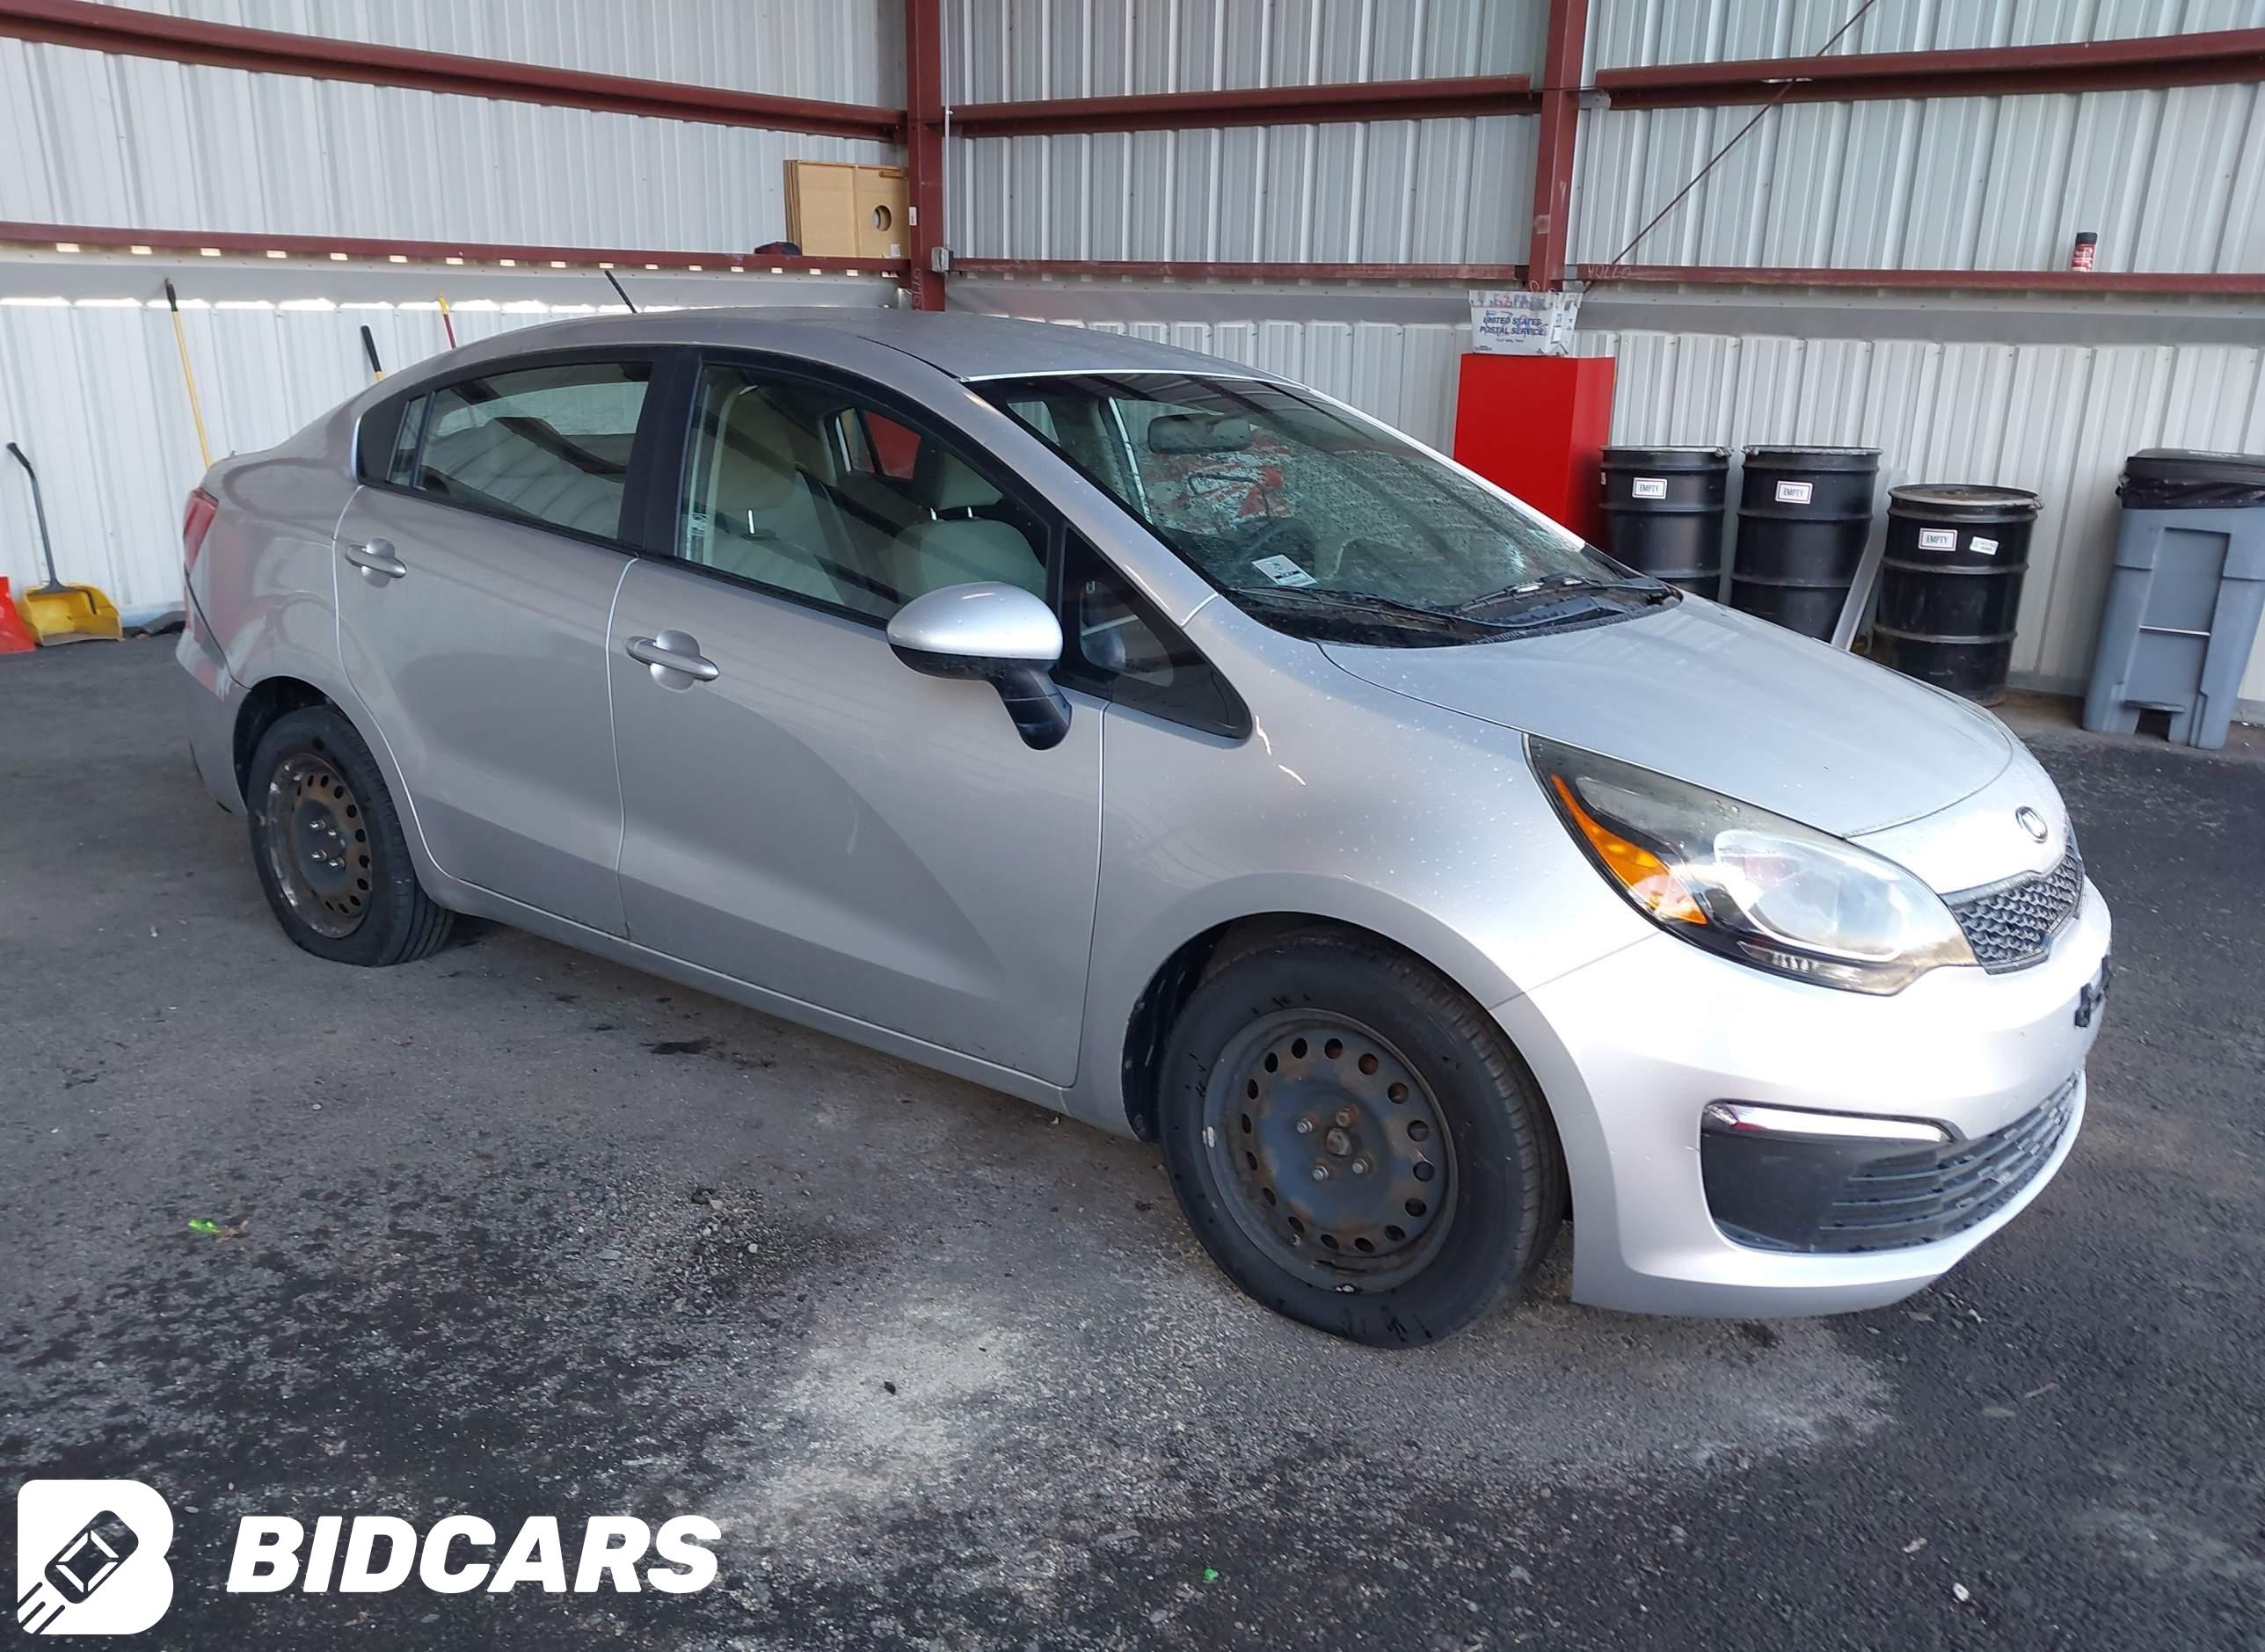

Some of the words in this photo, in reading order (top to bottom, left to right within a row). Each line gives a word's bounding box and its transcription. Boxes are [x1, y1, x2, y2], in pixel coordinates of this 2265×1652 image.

[1482, 317, 1511, 325] UNITED
[1511, 317, 1542, 326] STATES
[1479, 325, 1509, 335] POSTAL
[1639, 484, 1660, 493] EMPTY
[1783, 487, 1804, 499] EMPTY
[1926, 535, 1948, 544] EMPTY
